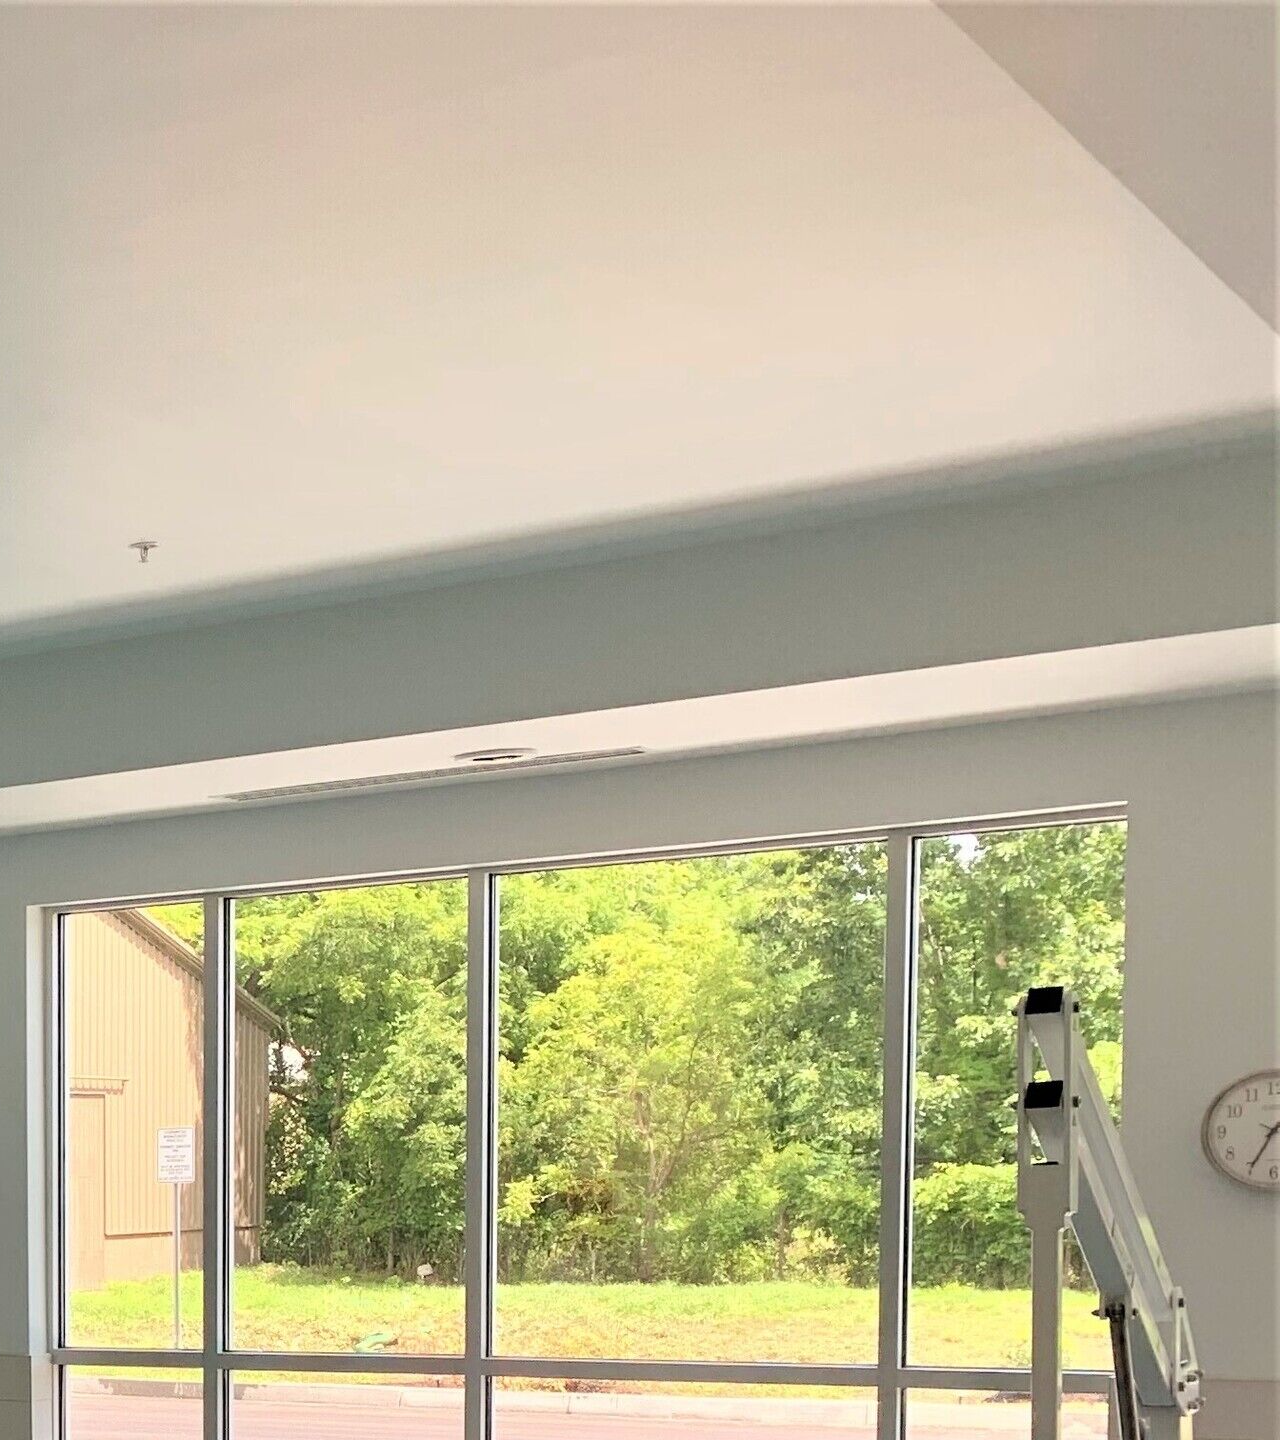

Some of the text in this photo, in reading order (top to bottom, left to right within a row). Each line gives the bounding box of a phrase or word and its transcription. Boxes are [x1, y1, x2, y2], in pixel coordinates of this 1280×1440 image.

[1247, 1088, 1258, 1102] 11
[1227, 1104, 1243, 1119] 10
[1217, 1125, 1227, 1140] 9
[1225, 1146, 1235, 1161] 8
[1269, 1165, 1279, 1180] 6
